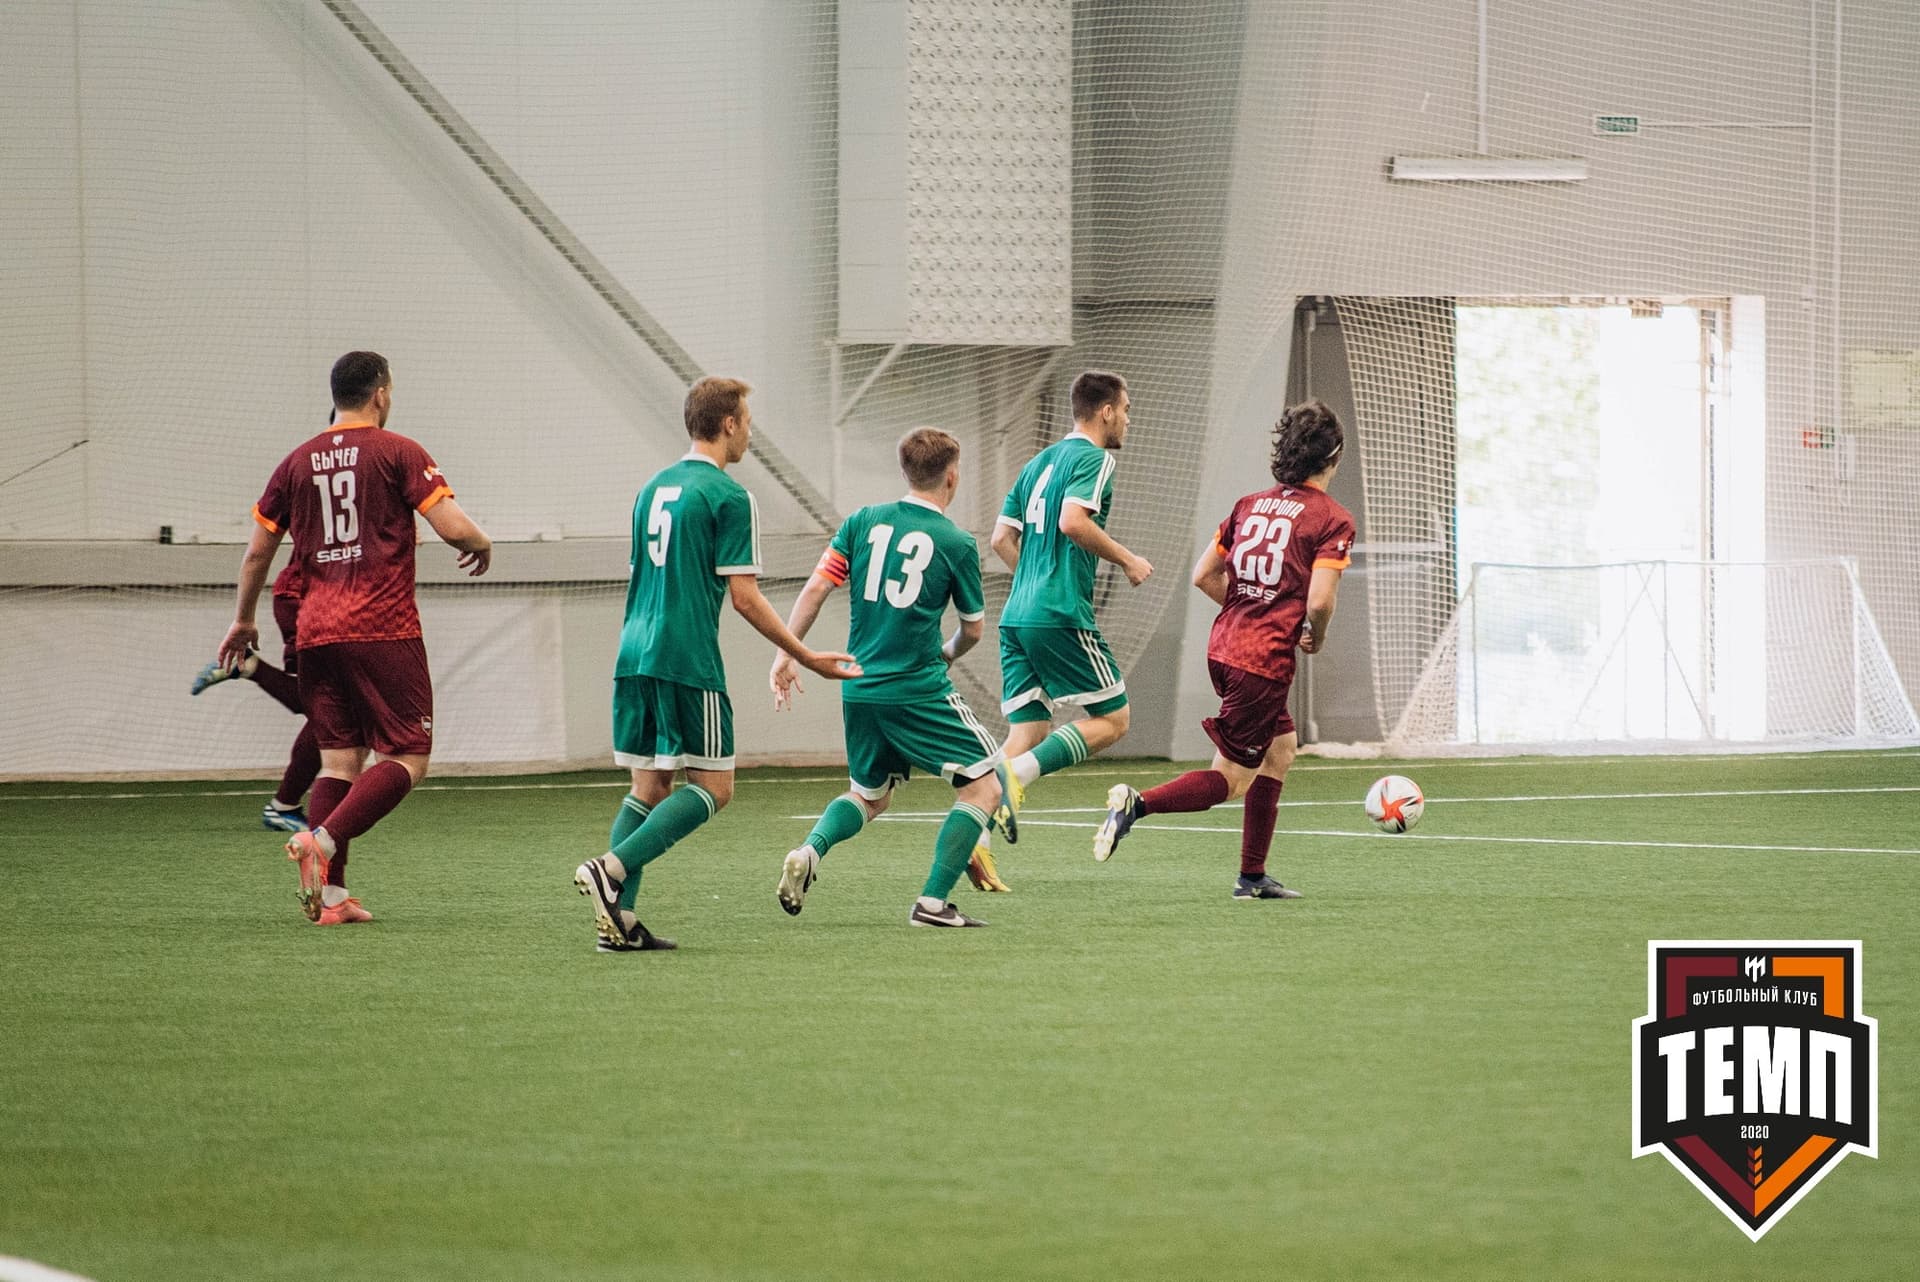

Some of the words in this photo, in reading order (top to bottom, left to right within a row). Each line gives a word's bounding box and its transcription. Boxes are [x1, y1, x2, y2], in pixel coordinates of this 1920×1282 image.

[311, 446, 359, 472] СЫЧЕВ
[312, 470, 360, 545] 13
[647, 486, 683, 567] 5
[1025, 463, 1055, 534] 4
[1251, 498, 1305, 519] ВОРОНА
[316, 544, 362, 563] SEUS
[863, 523, 935, 609] 13
[1232, 515, 1293, 586] 23
